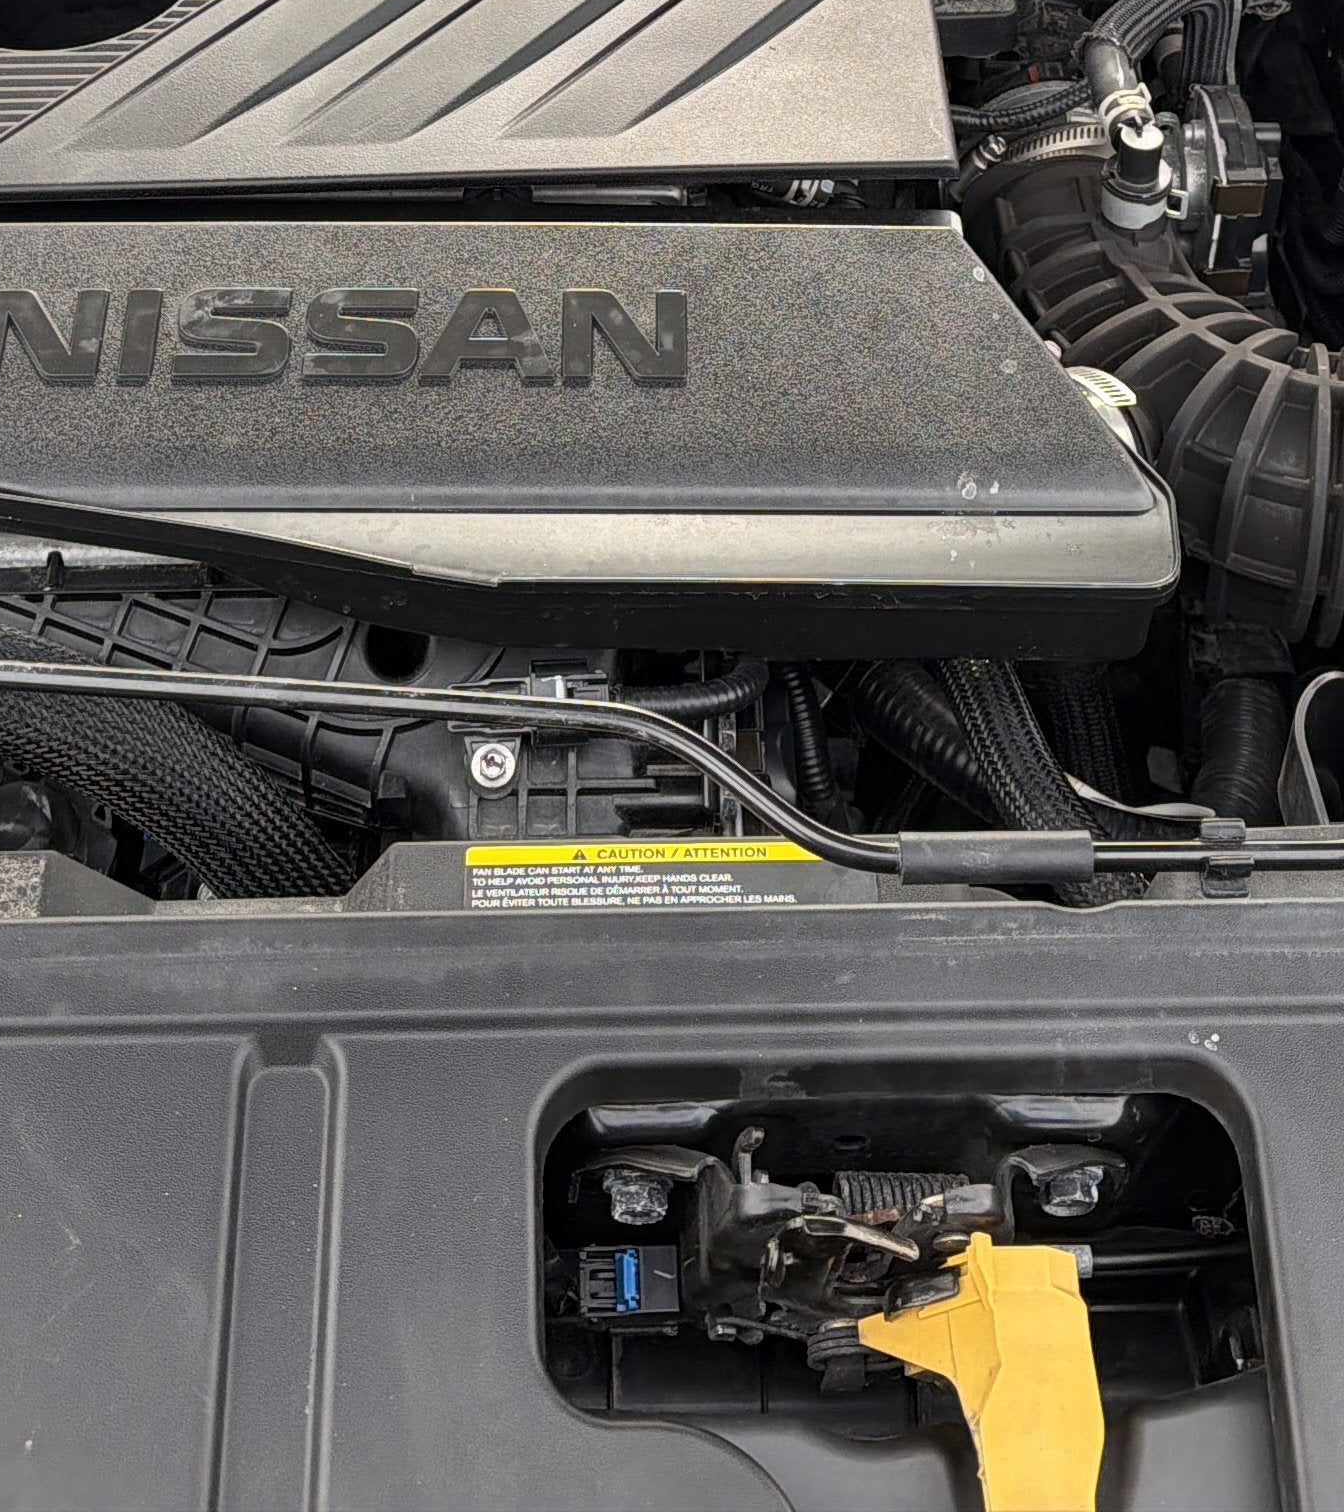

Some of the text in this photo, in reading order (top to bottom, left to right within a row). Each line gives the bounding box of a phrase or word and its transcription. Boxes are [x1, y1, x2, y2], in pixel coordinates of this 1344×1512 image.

[596, 849, 665, 860] CAUTION
[684, 847, 767, 858] ATTENTION
[472, 865, 644, 876] FAN BLADE CAN START AT ANY TIME.
[472, 878, 486, 886] TO
[488, 877, 513, 886] HELP
[515, 877, 545, 885] AVOID
[547, 876, 600, 885] PERSONAL
[662, 874, 697, 883] HANDS
[699, 873, 734, 882] CLEAR.
[471, 884, 744, 898] LE VENTILATEUR RISQUE DE DÉMARRER À TOUT MOMENT.
[471, 899, 500, 908] POUR
[502, 897, 536, 907] ÉVITER
[537, 898, 569, 906] TOUTE
[627, 896, 641, 905] NE
[643, 896, 663, 905] PAS
[665, 896, 678, 904] EN
[680, 895, 742, 904] APPROCHER
[743, 895, 762, 904] LES
[764, 894, 798, 903] MAINS.
